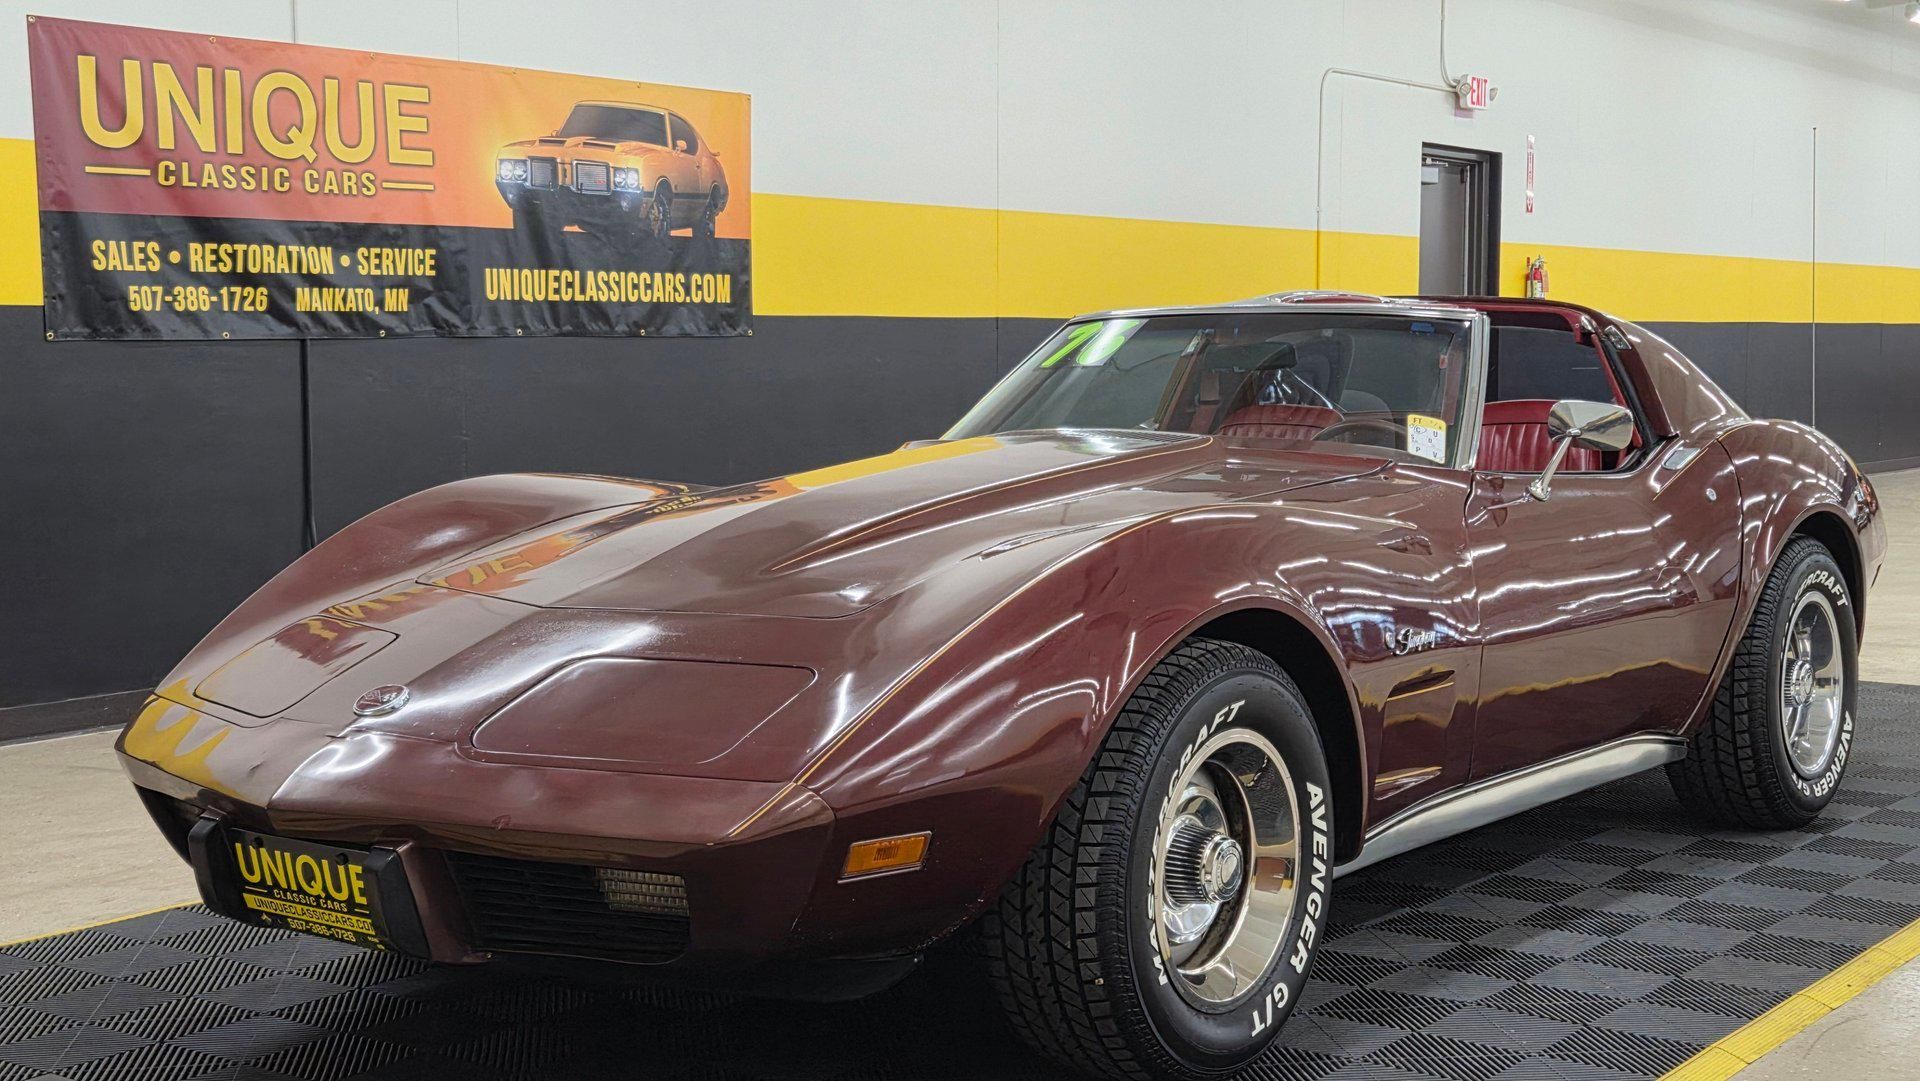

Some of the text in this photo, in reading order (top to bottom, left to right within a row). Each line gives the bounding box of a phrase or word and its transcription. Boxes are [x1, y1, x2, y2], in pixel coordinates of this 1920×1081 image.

[1470, 76, 1488, 107] EXIT
[77, 55, 434, 166] UNIQUE
[157, 160, 377, 196] CLASSIC CARS
[91, 240, 437, 277] SALES RESTORATION SERVICE
[128, 286, 409, 314] 507-386-1726 MANKATO, MN
[485, 268, 731, 304] UNIQUECLASSICCARS.COM
[1812, 710, 1853, 797] AVENGER
[235, 842, 369, 905] UNIQUE
[273, 889, 348, 912] CLASSIC CARS
[1250, 782, 1329, 1039] AVENGER G/T
